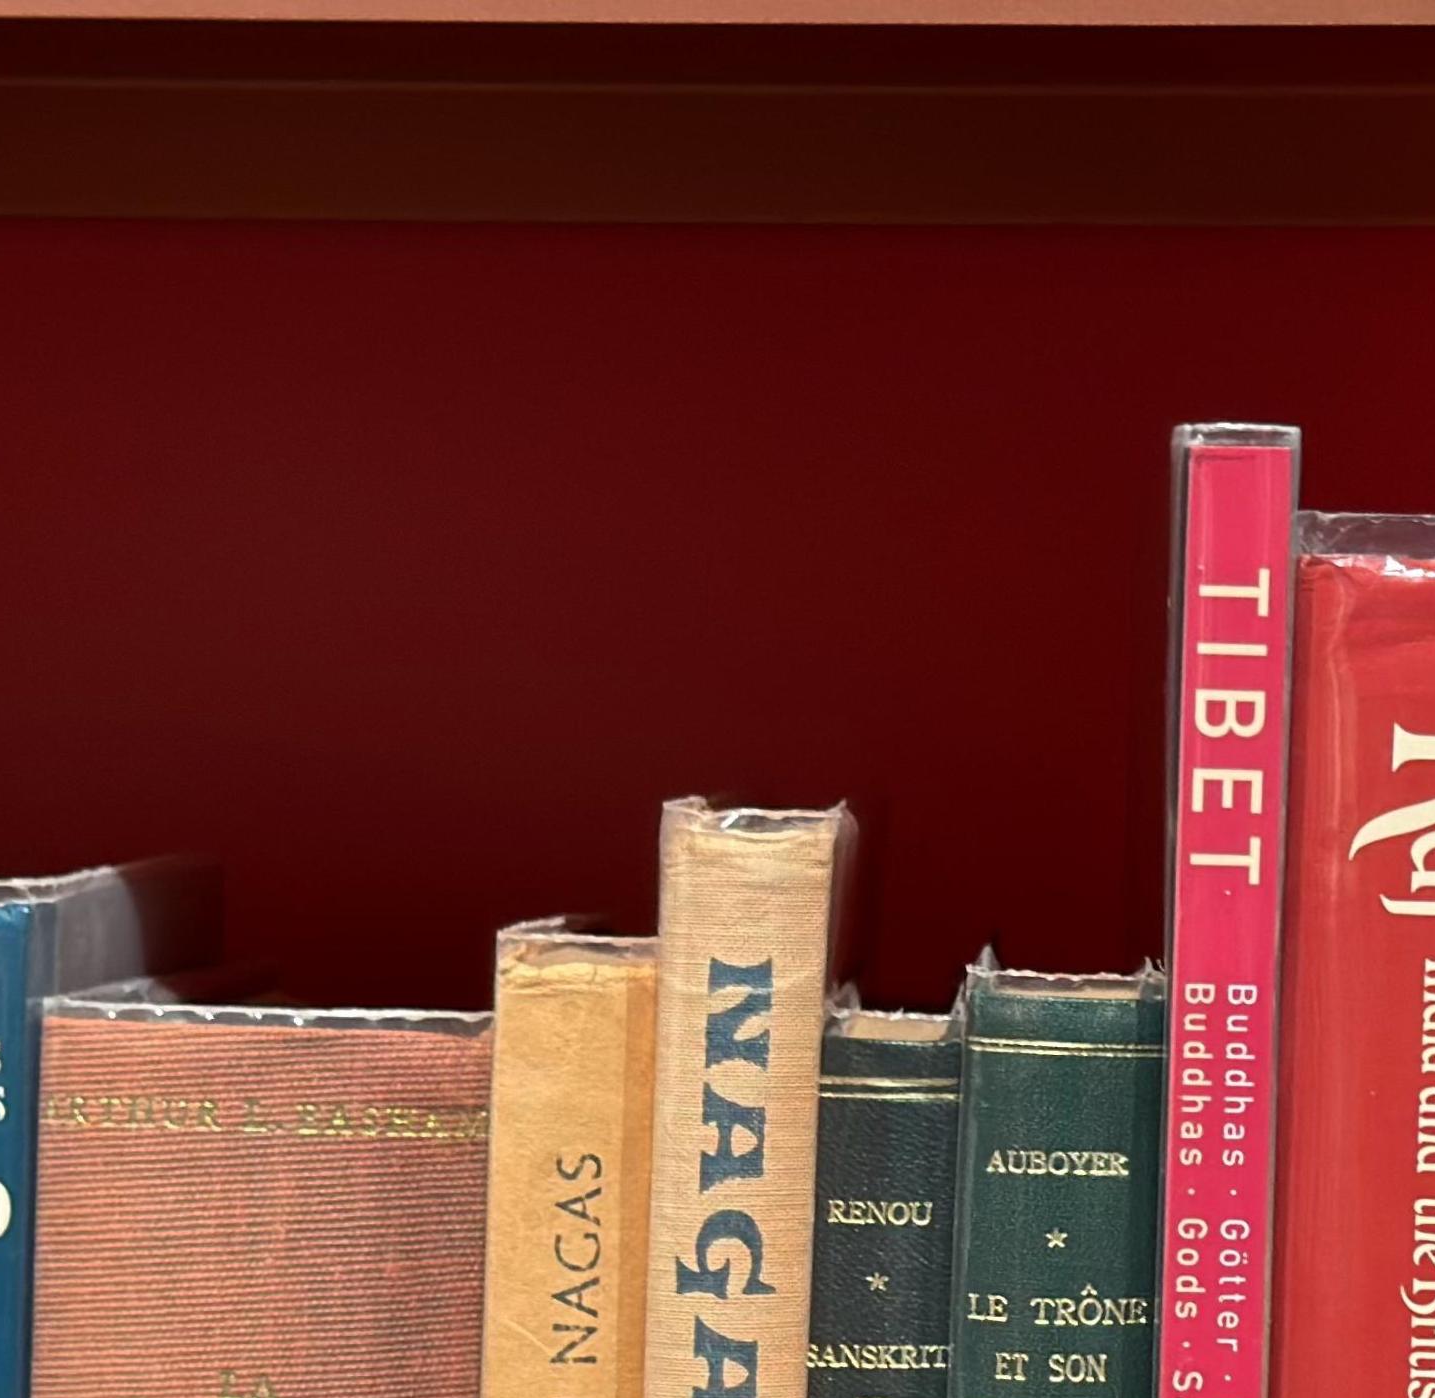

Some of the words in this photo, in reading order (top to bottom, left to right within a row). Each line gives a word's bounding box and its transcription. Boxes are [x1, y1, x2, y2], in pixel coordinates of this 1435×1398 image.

[1189, 567, 1271, 886] TIBET
[1178, 982, 1216, 1167] Buddhas
[1222, 983, 1259, 1167] Buddhas
[38, 1097, 223, 1132] ARTHUR
[985, 1149, 1130, 1177] AUBOYER
[827, 1199, 934, 1227] RENOU
[549, 1152, 604, 1365] NAGAS
[1174, 1216, 1209, 1320] Gods
[1214, 1218, 1251, 1353] Götter
[966, 1292, 1009, 1323] LE
[1030, 1282, 1149, 1327] TRÔNE
[805, 1343, 953, 1370] SANSKRIT
[994, 1352, 1029, 1381] ET
[1048, 1353, 1108, 1383] SON
